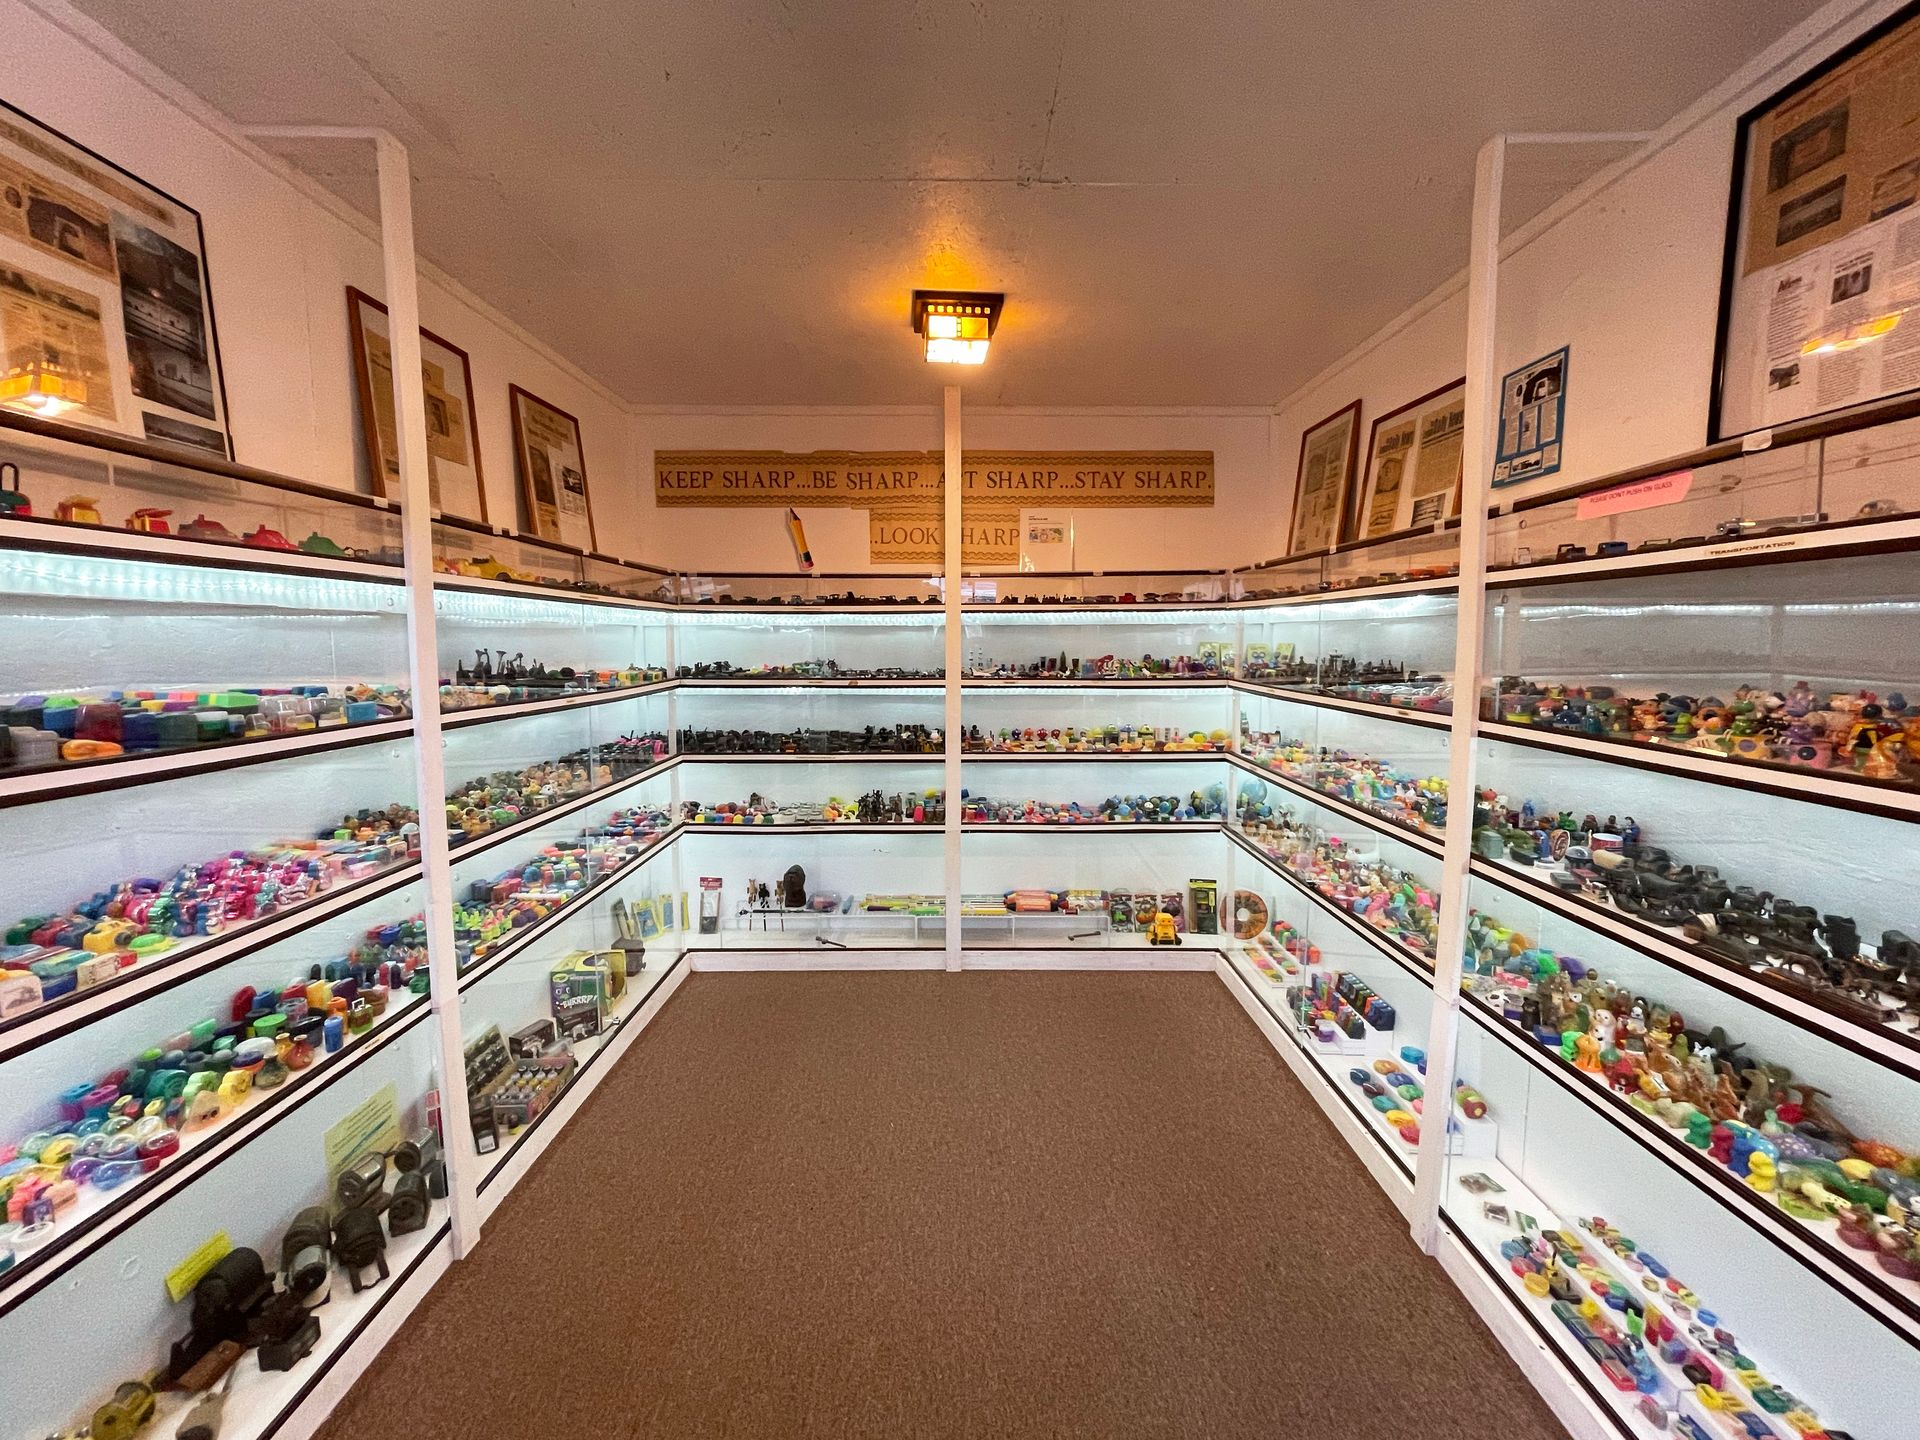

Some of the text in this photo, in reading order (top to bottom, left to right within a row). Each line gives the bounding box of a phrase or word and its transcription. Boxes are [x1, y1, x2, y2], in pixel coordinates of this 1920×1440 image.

[659, 470, 714, 489] KEEP
[1134, 470, 1212, 489] SHARP.
[1590, 494, 1609, 503] PLEASE
[1626, 487, 1642, 496] PUSH
[1643, 485, 1653, 493] ON
[1654, 481, 1672, 490] GLASS
[961, 527, 1020, 546] HARP
[1710, 541, 1796, 556] TRANSPORTATION
